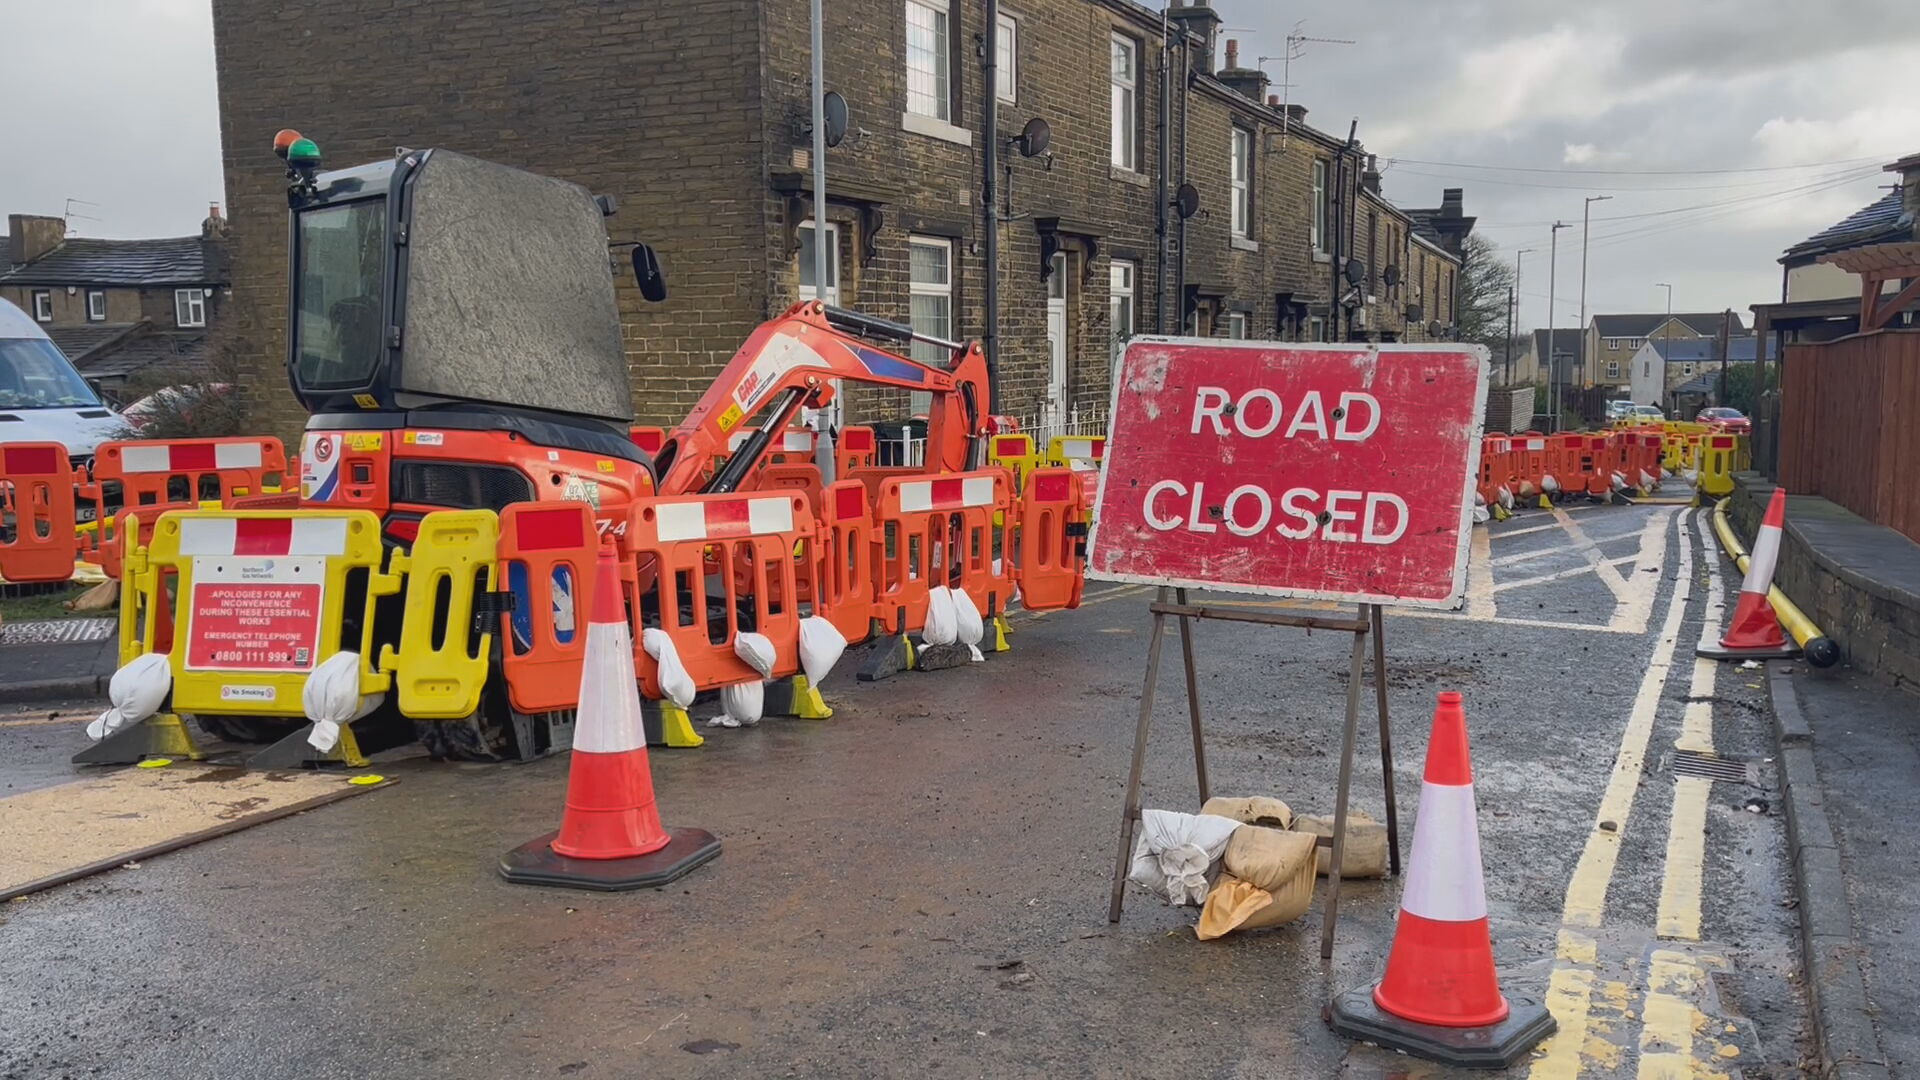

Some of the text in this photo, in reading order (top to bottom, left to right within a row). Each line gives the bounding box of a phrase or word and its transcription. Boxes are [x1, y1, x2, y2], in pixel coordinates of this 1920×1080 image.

[1191, 386, 1382, 442] ROAD
[1143, 479, 1409, 545] CLOSED
[212, 590, 303, 599] APOLOGIES FOR ANY
[221, 599, 292, 608] INCONVENIENCE
[200, 608, 311, 617] DURING THESE ESSENTIAL
[239, 617, 271, 625] WORKS
[204, 632, 301, 641] EMERGENCY TELEPHONE
[235, 640, 269, 648] NUMBER
[215, 651, 288, 662] 0800 111 999
[241, 689, 265, 697] Smoking
